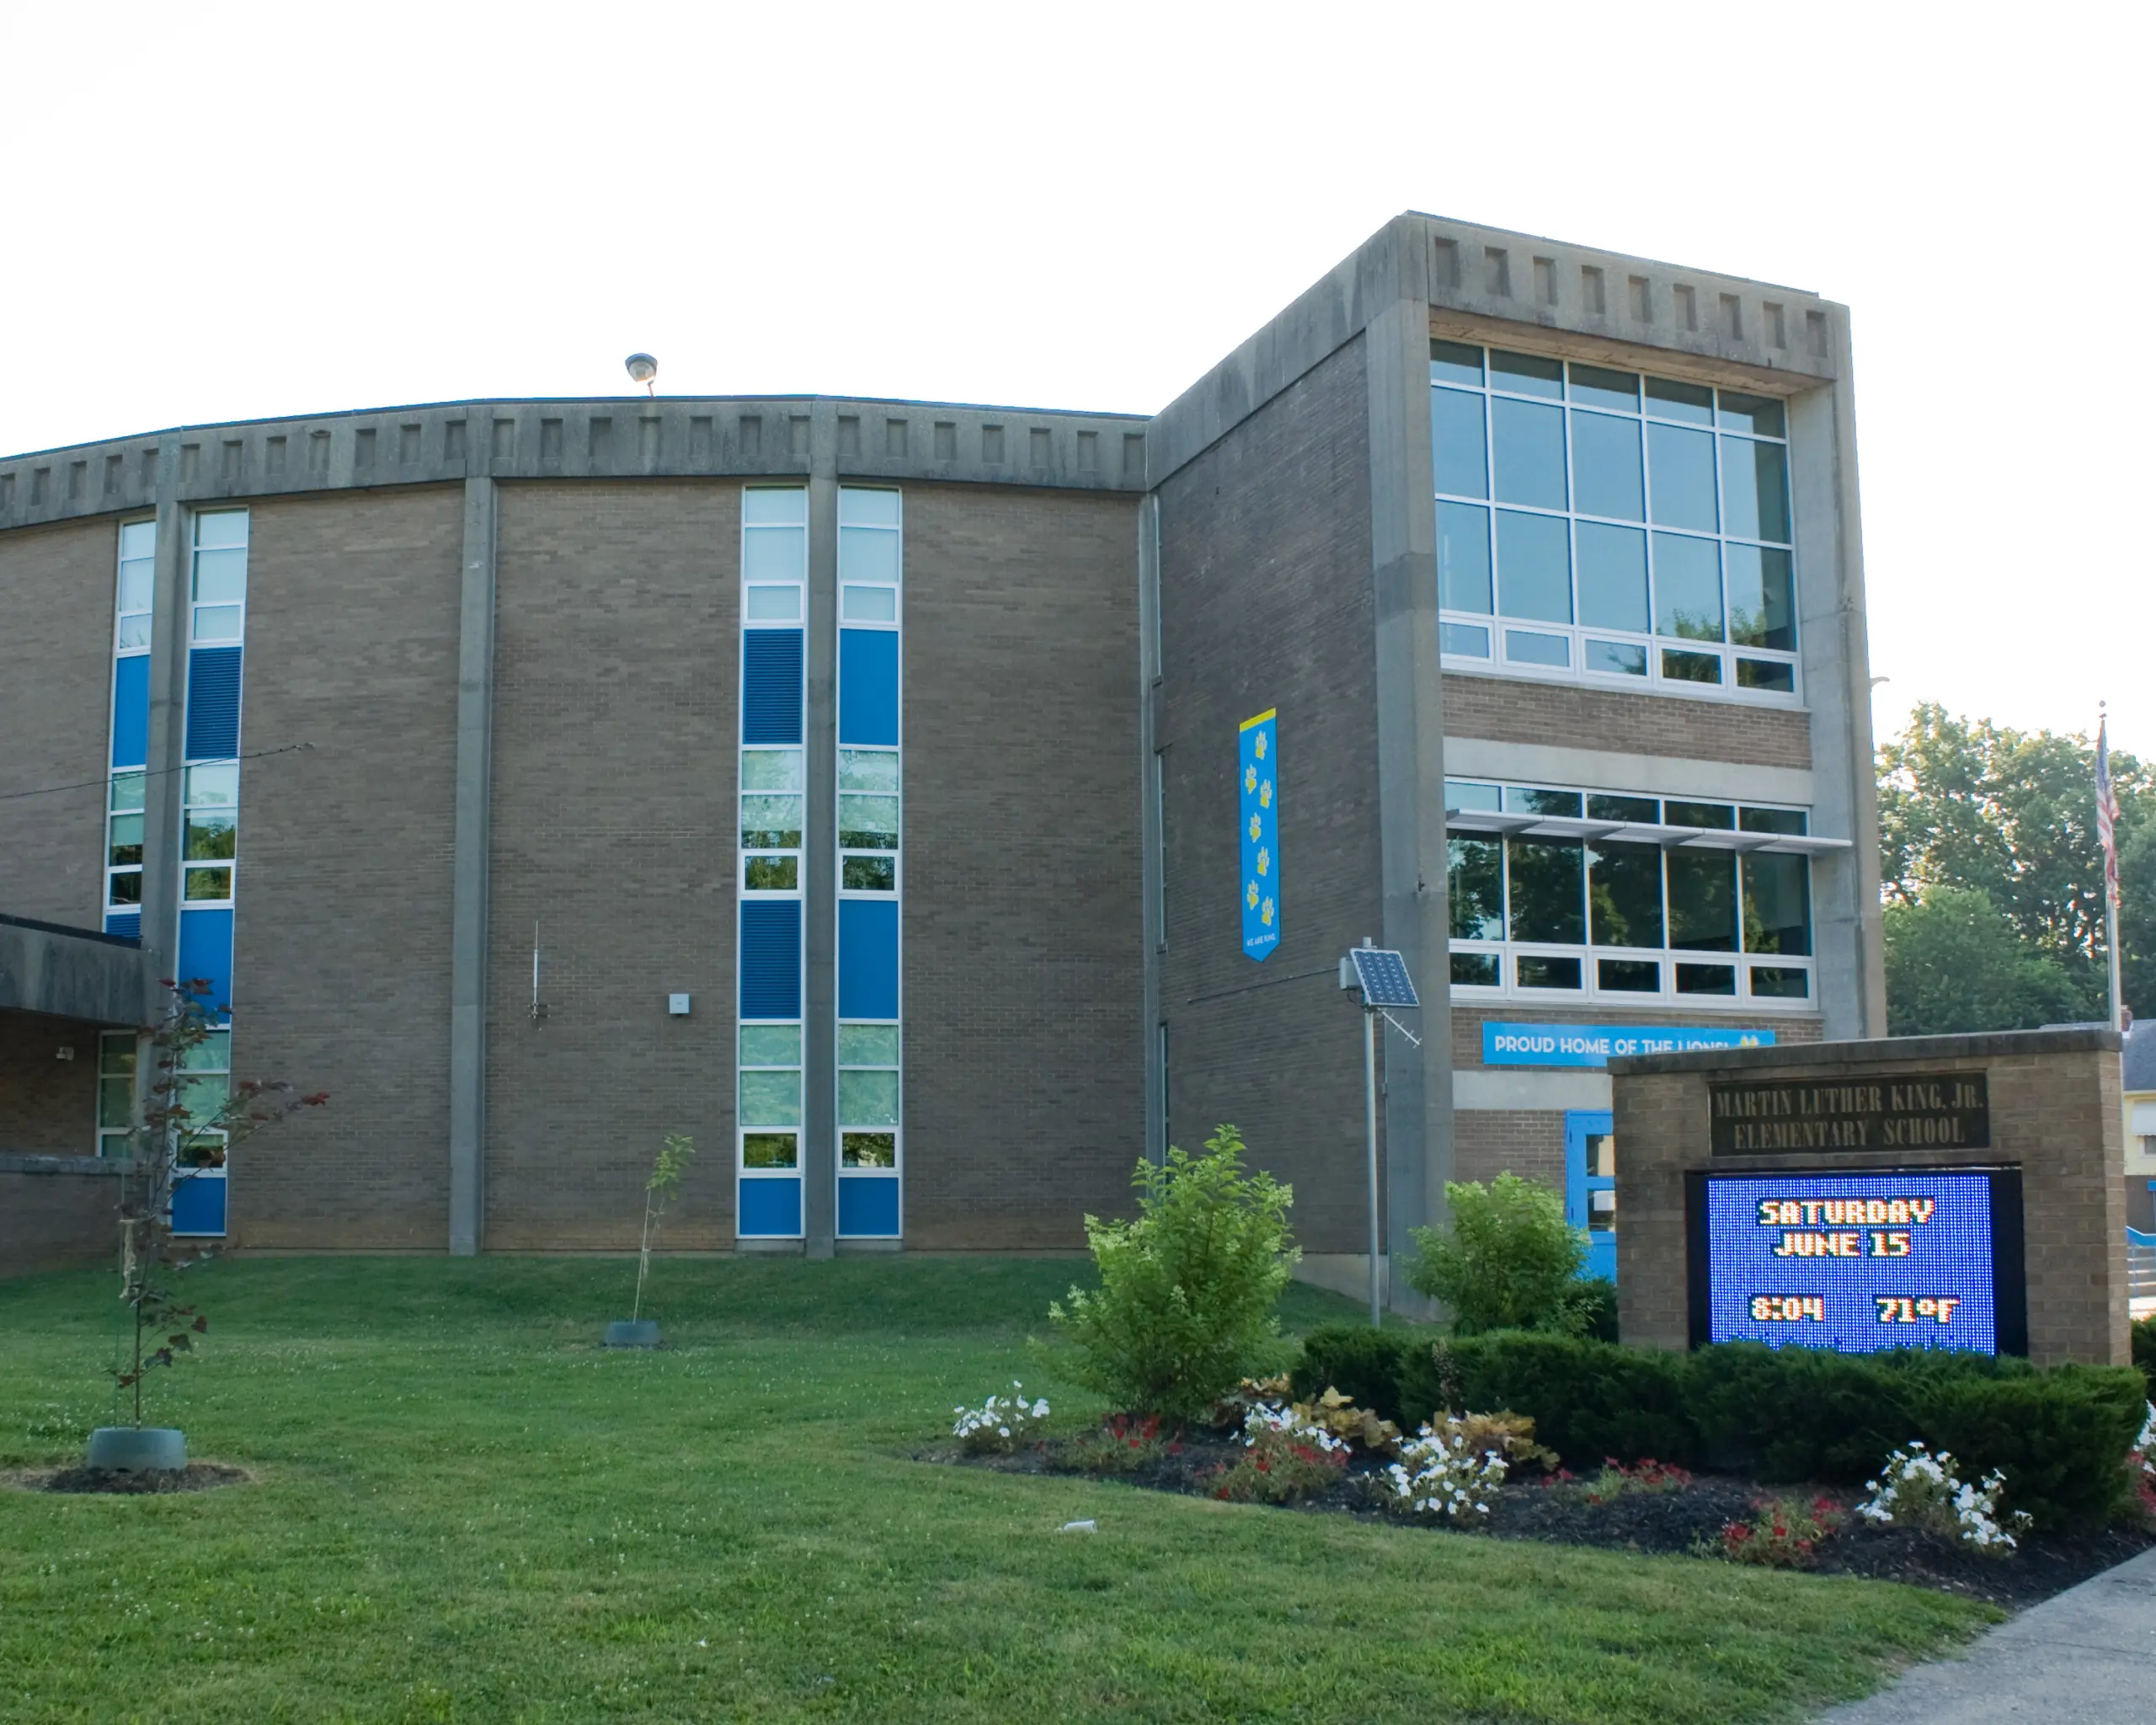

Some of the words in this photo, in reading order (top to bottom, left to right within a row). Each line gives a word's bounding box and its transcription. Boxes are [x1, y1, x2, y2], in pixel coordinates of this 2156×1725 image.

[1494, 1035, 1555, 1053] PROUD
[1560, 1037, 1611, 1055] HOME
[1614, 1039, 1637, 1055] OF
[1643, 1039, 1673, 1053] THE
[1716, 1089, 1792, 1118] MARTIN
[1800, 1086, 1882, 1114] LUTHER
[1892, 1083, 1948, 1111] KING,
[1734, 1119, 1869, 1150] ELEMENTARY
[1883, 1117, 1966, 1146] SCHOOL
[1758, 1199, 1935, 1226] SATURDAY
[1774, 1231, 1861, 1258] JUNE
[1870, 1231, 1911, 1258] 15
